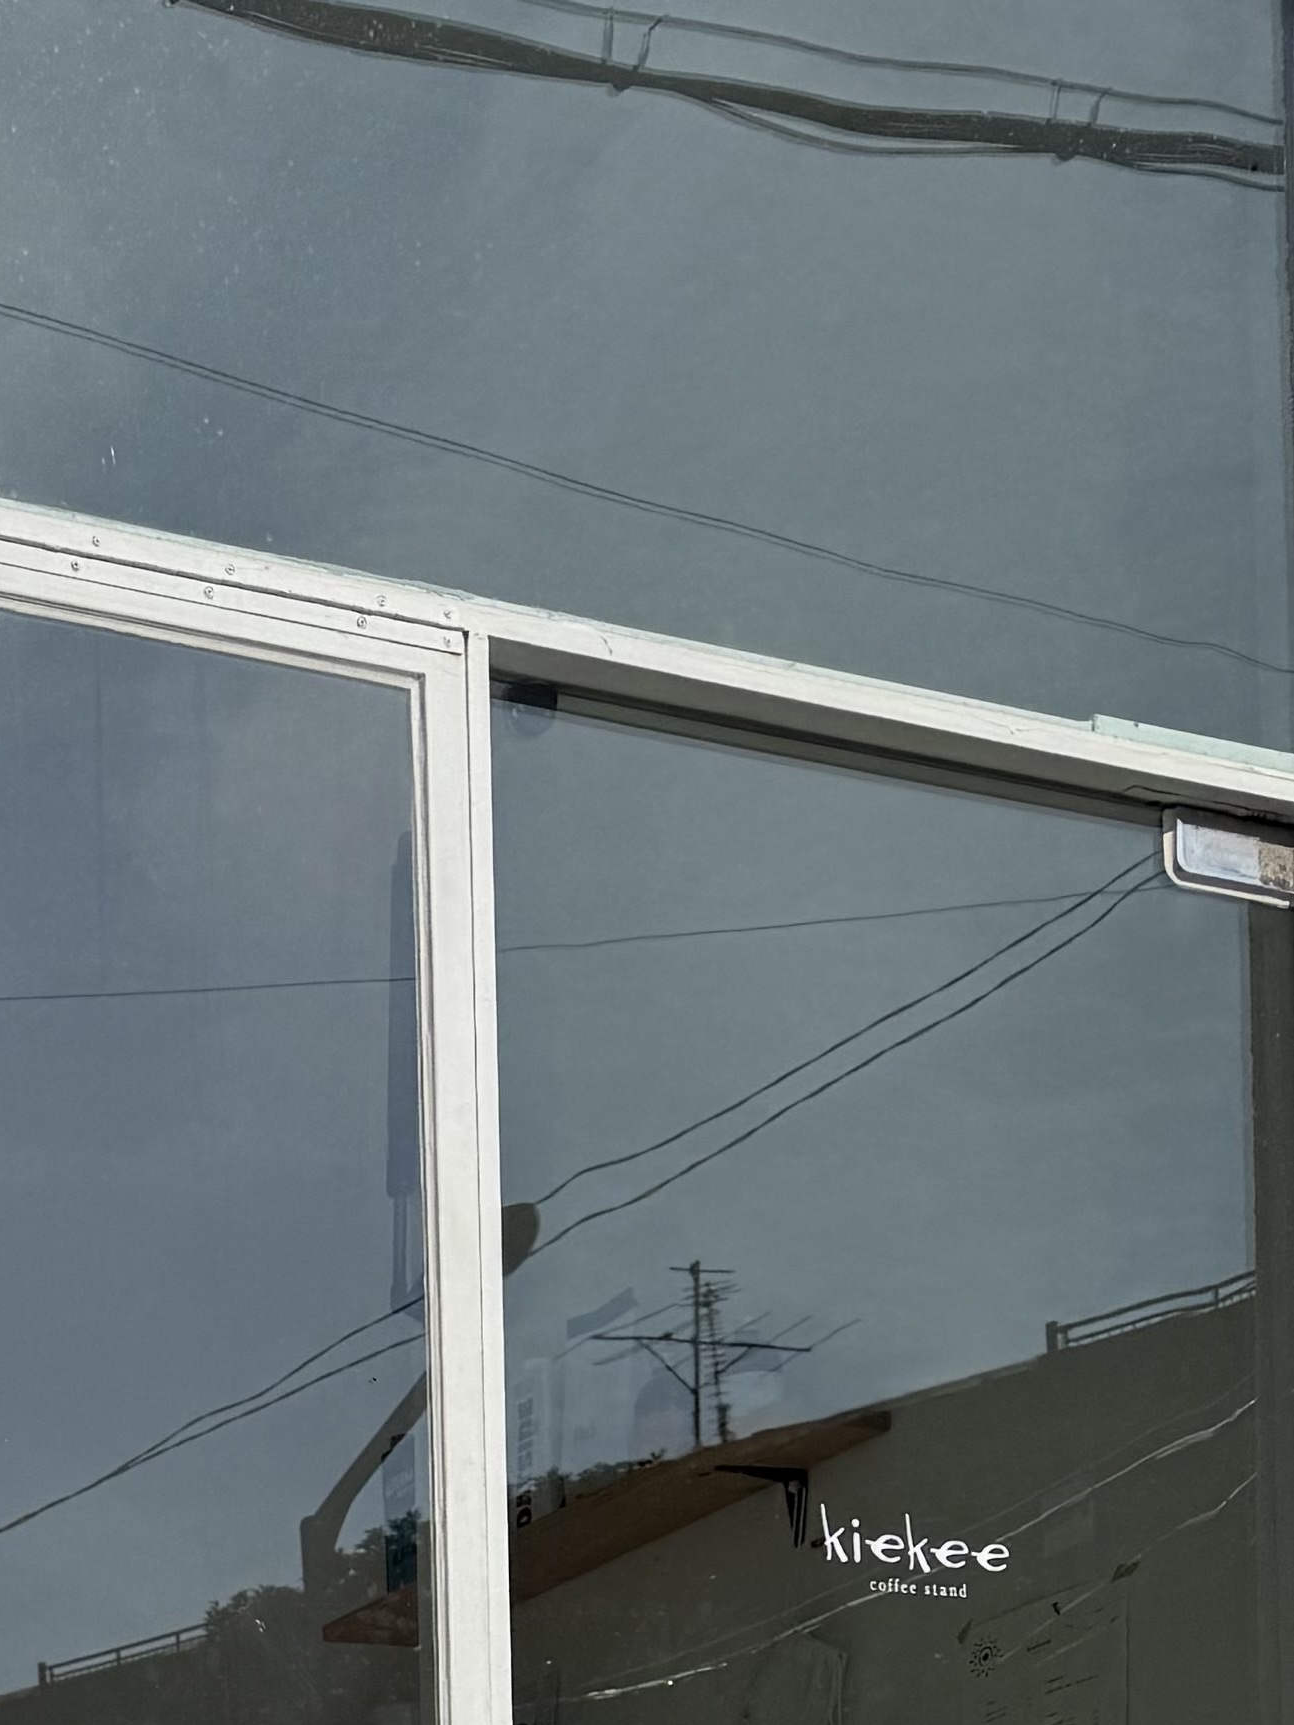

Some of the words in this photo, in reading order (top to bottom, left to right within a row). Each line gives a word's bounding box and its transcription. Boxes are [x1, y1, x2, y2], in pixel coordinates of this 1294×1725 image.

[819, 1502, 1011, 1574] kiekee
[869, 1577, 917, 1595] coffee
[924, 1583, 968, 1599] stand
